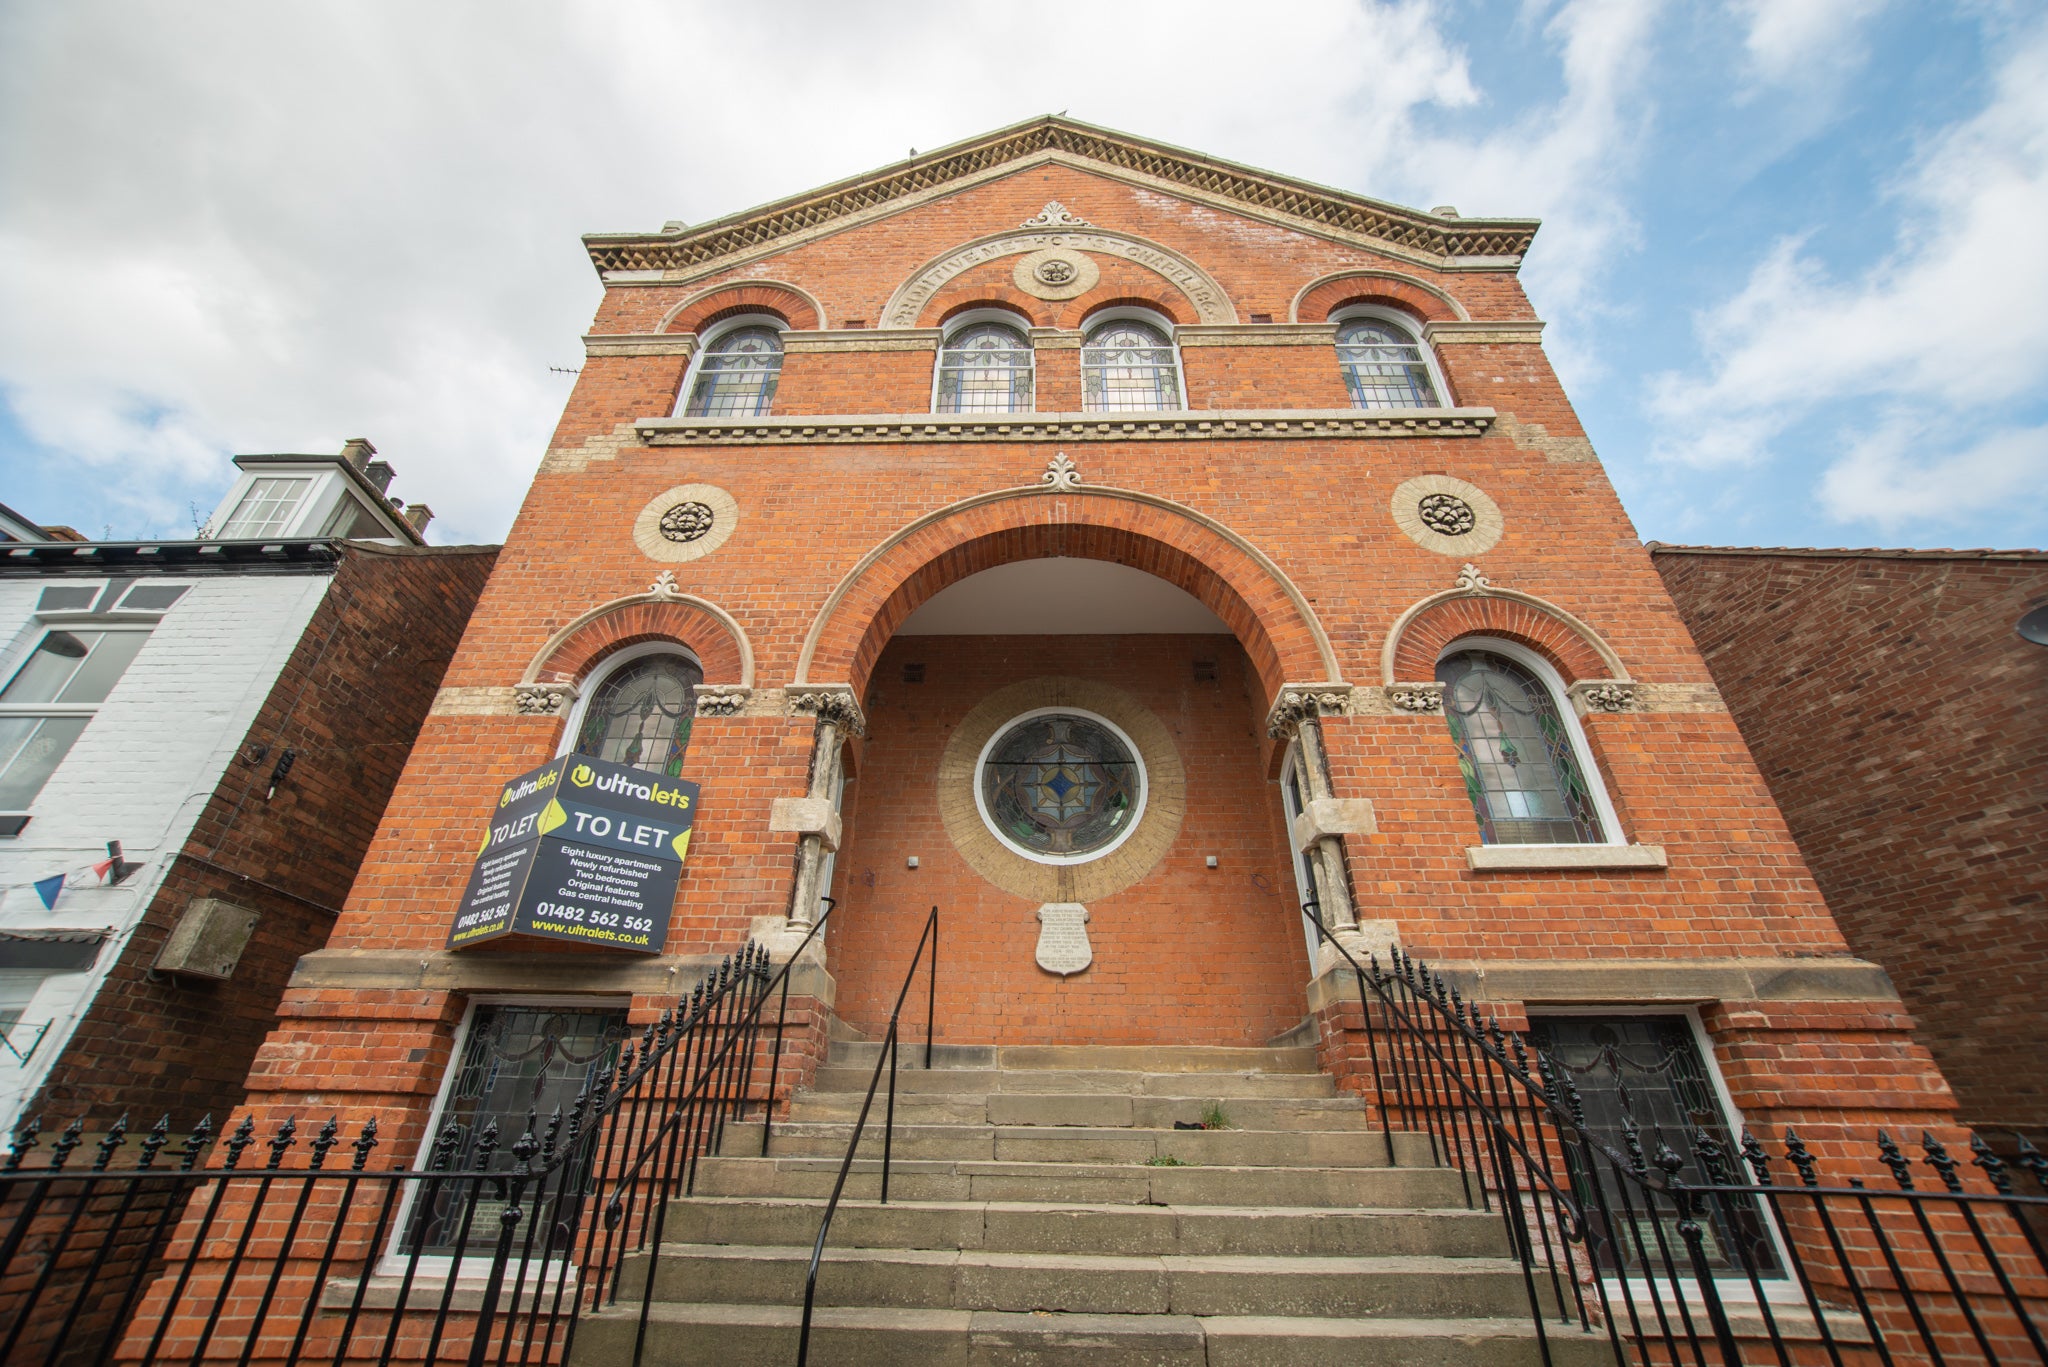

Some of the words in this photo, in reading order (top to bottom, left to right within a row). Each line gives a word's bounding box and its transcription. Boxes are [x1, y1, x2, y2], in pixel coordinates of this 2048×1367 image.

[893, 251, 979, 326] PRIMITIVE
[982, 236, 1124, 257] METHODIST
[510, 769, 558, 803] ultralets
[596, 773, 690, 809] ultralets
[491, 823, 509, 846] TO
[509, 812, 539, 838] LET
[574, 811, 611, 837] TO
[617, 821, 670, 849] LET
[561, 845, 585, 858] Eight
[586, 850, 613, 864] luxury
[614, 856, 662, 872] apartments
[570, 858, 598, 871] Newly
[599, 863, 649, 879] refurbished
[568, 878, 603, 892] Original
[604, 885, 640, 898] features
[575, 869, 594, 880] Two
[595, 873, 639, 888] bedrooms
[558, 888, 577, 898] Gas
[578, 892, 610, 903] central
[611, 896, 644, 910] heating
[458, 912, 480, 929] 01482
[479, 907, 495, 923] 562
[494, 903, 511, 919] 562
[537, 902, 585, 922] 01482
[589, 910, 619, 927] 562
[623, 916, 653, 932] 562
[453, 919, 505, 942] www.ultralets.co.uk
[532, 920, 649, 946] www.ultralets.co.uk
